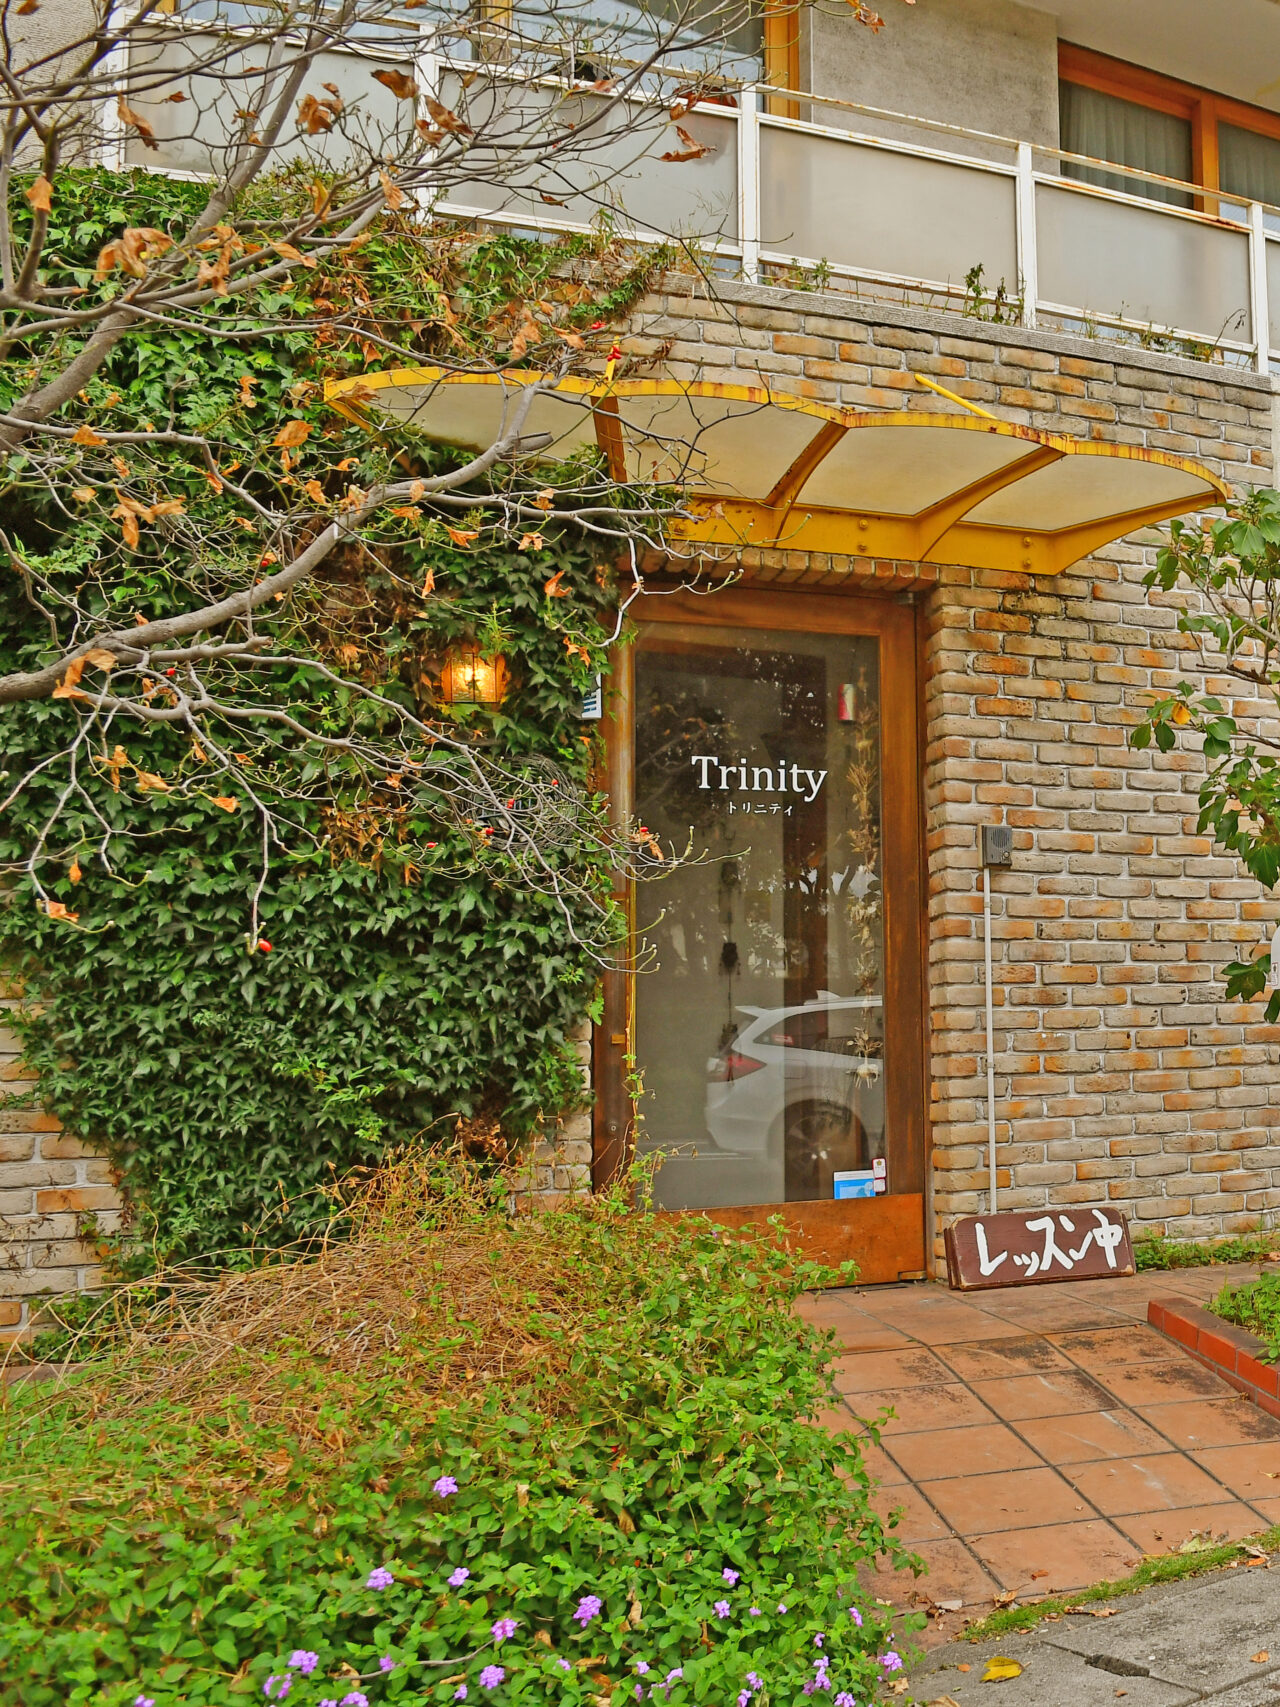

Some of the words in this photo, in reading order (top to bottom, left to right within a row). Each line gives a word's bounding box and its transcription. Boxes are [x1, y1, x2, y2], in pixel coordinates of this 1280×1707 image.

[691, 755, 828, 803] Trinity
[729, 801, 793, 817] トリニティ
[975, 1208, 1123, 1277] レッスン中
